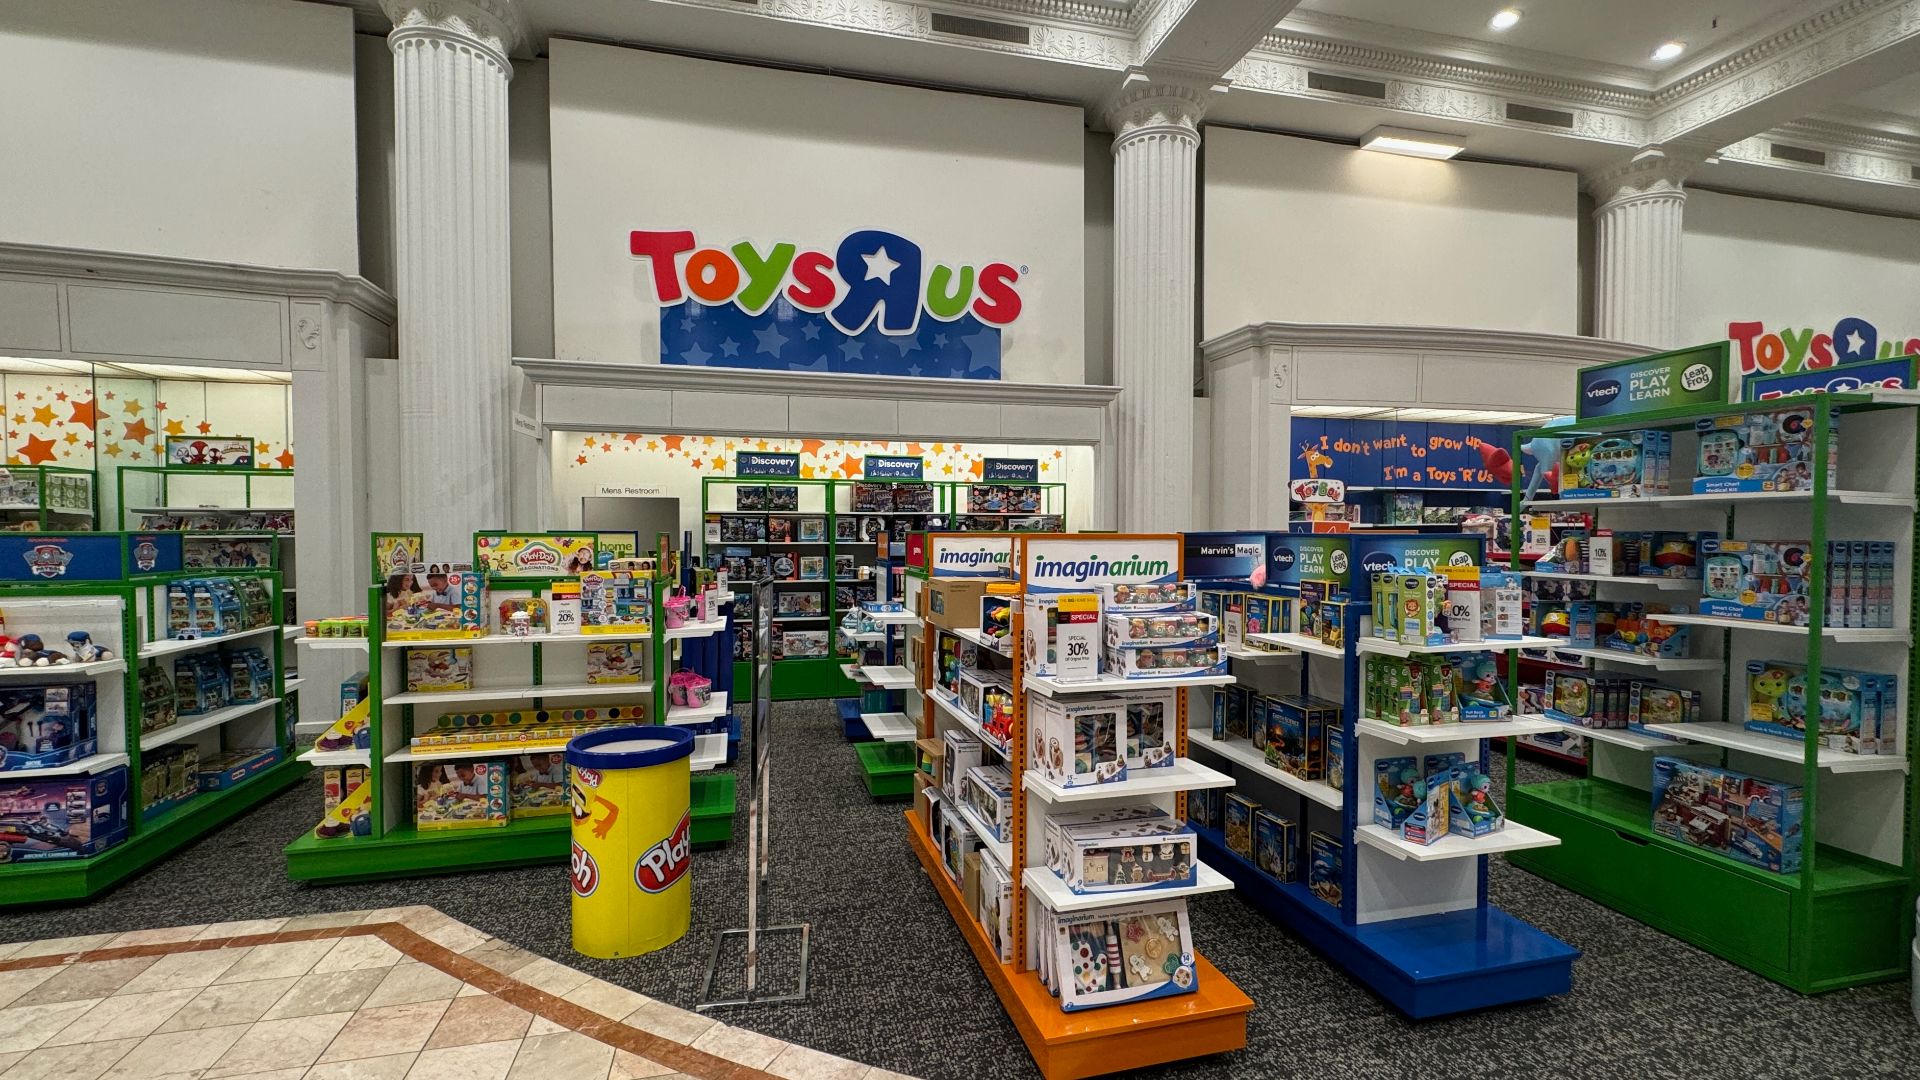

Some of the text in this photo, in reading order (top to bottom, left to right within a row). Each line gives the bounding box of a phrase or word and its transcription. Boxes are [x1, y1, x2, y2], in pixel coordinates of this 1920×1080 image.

[1630, 366, 1670, 378] DISCOVER
[1684, 366, 1707, 381] Leap
[1630, 375, 1670, 391] PLAY
[1687, 375, 1710, 388] Frog
[1587, 386, 1618, 398] vtech
[1630, 387, 1670, 401] LEARN
[1319, 433, 1482, 458] I don't want to grow up
[751, 456, 795, 467] Discovery
[878, 458, 920, 470] Discovery
[996, 462, 1034, 472] Discovery
[1384, 466, 1408, 481] I'm
[1412, 471, 1422, 482] a
[1426, 466, 1456, 484] Toys
[1477, 469, 1494, 483] Us
[600, 541, 633, 551] home
[1200, 545, 1259, 556] Marvin's Magic
[939, 548, 1010, 568] imaginar
[1595, 548, 1607, 557] 10%
[1273, 554, 1294, 563] vtech
[1300, 553, 1324, 564] PLAY
[1331, 553, 1345, 564] Leap
[1404, 558, 1440, 569] PLAY
[1450, 554, 1469, 567] Leap
[1034, 554, 1169, 583] imaginarium
[1300, 564, 1325, 575] LEARN
[1333, 561, 1347, 571] Frog
[1363, 561, 1396, 571] vtech
[558, 613, 575, 622] 20%
[1067, 642, 1089, 656] 30%
[1057, 914, 1095, 925] imaginarium
[1182, 954, 1190, 962] 14
